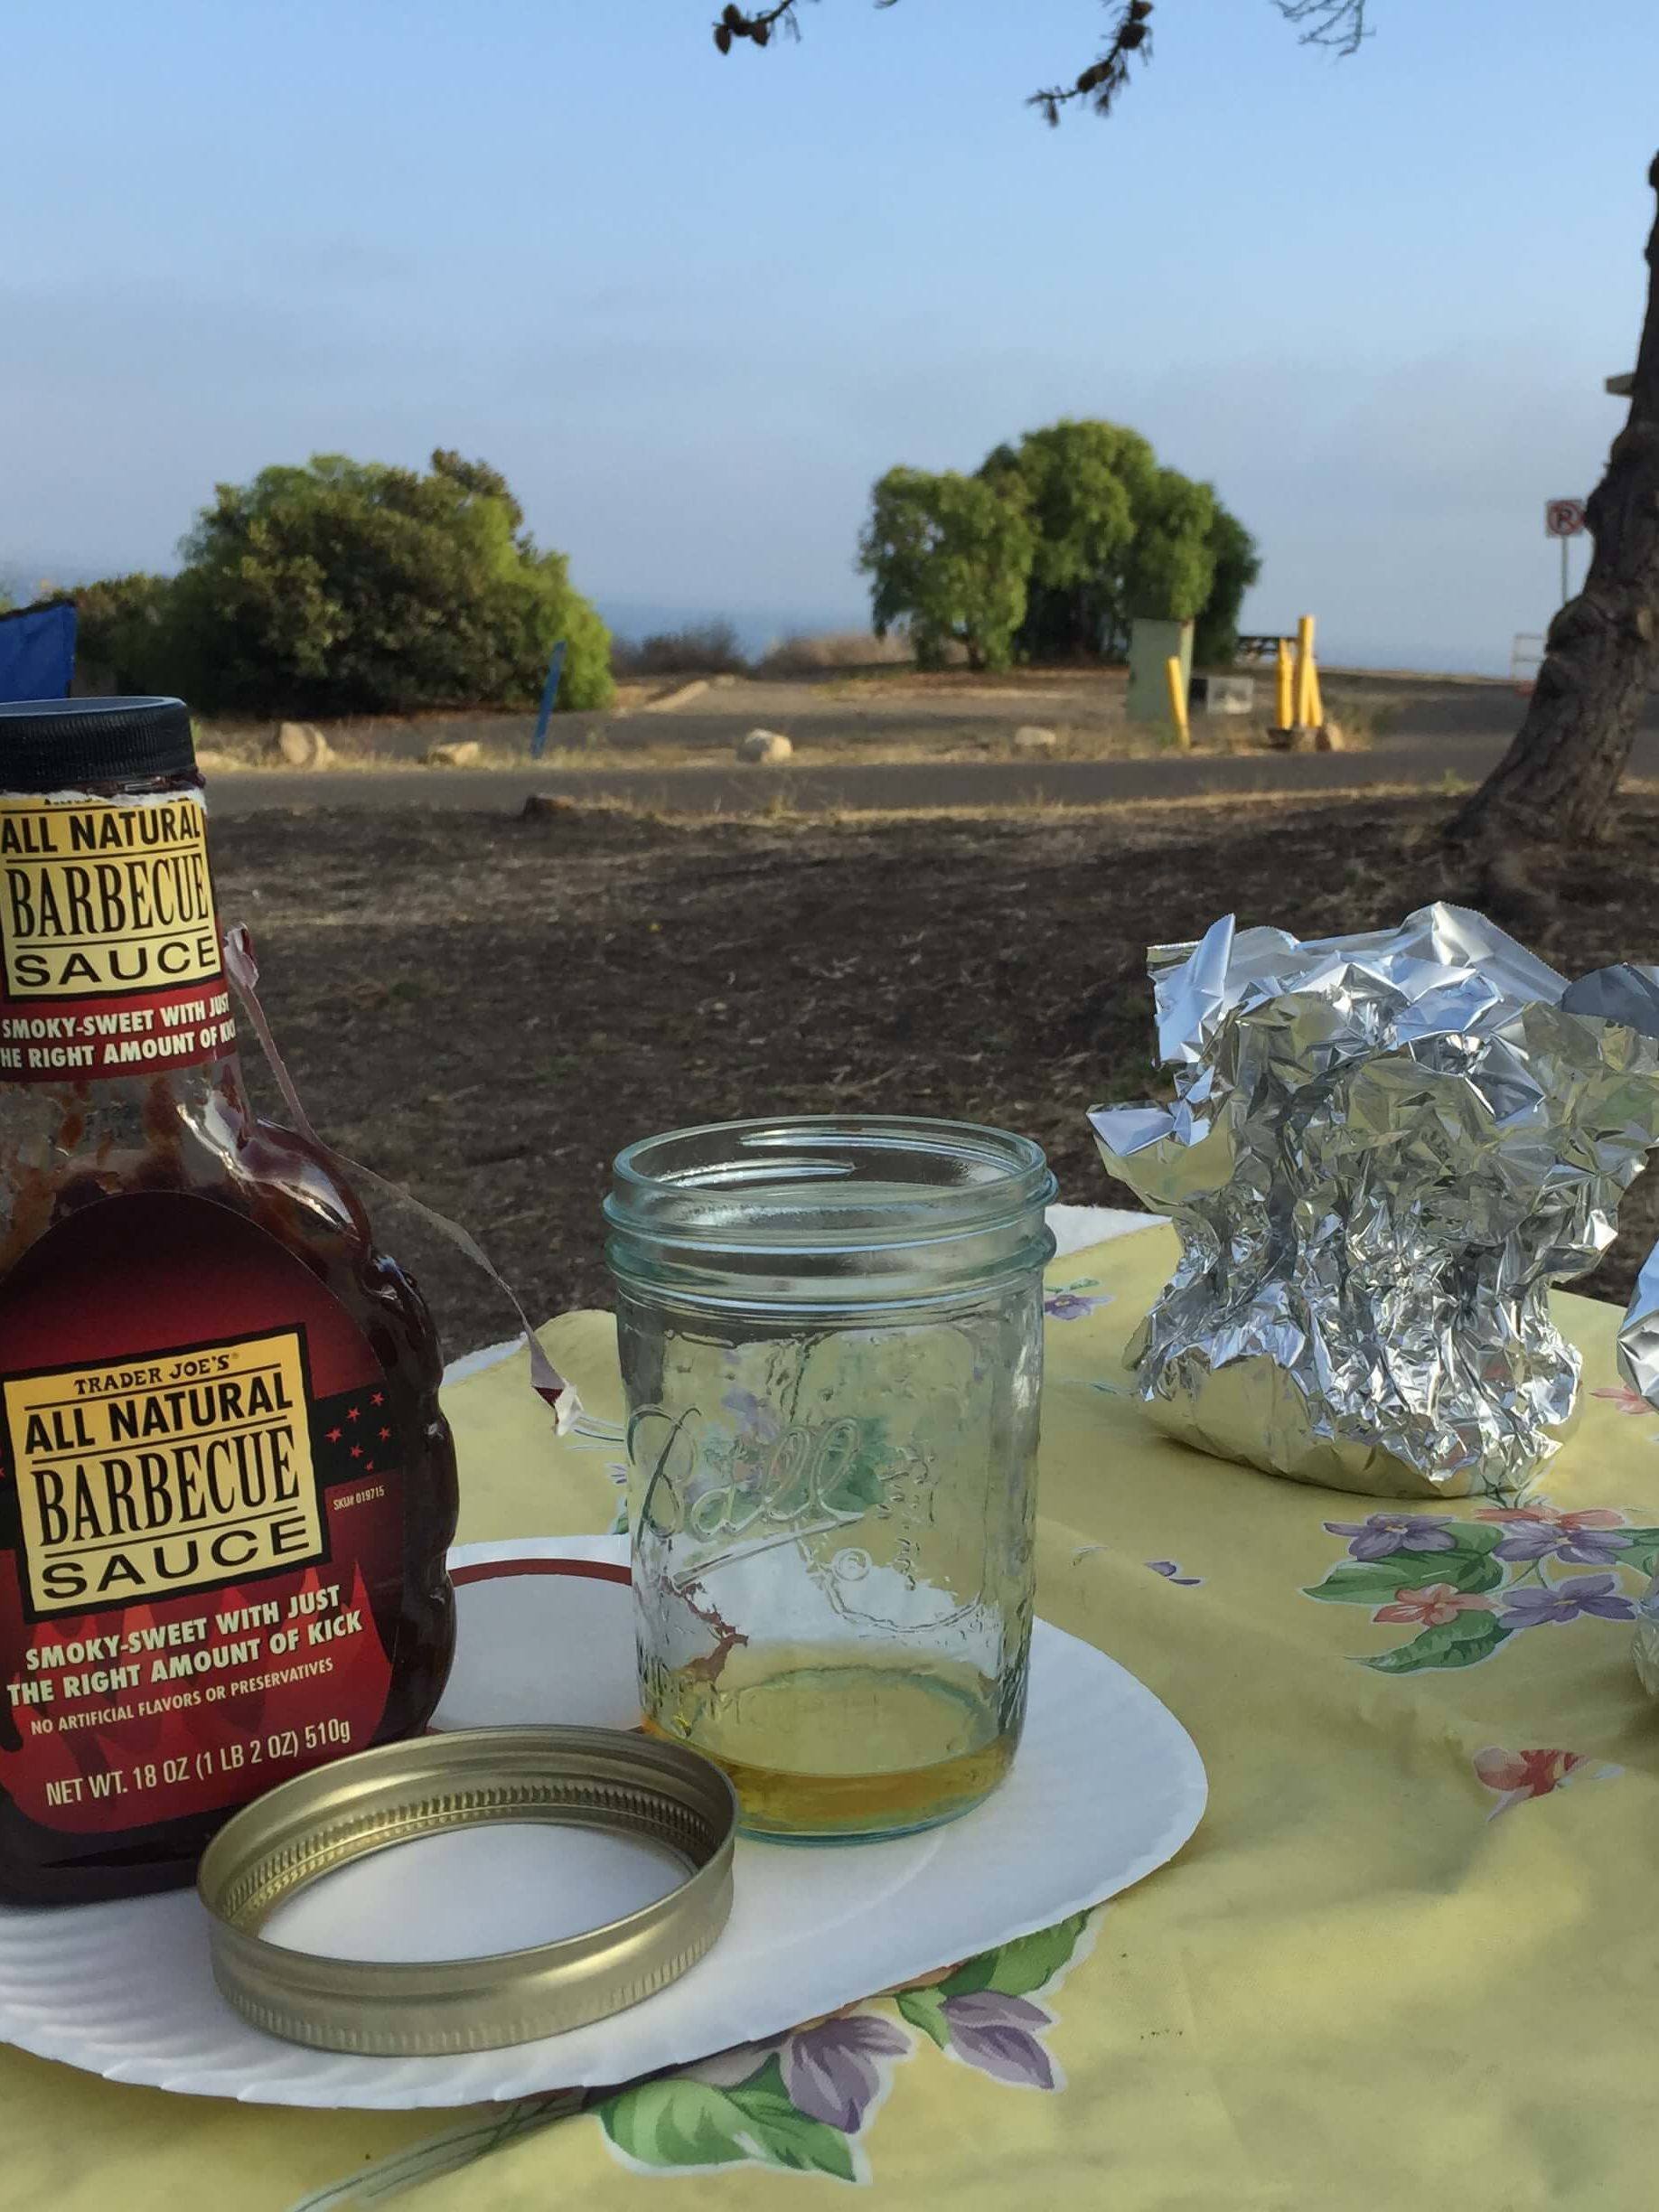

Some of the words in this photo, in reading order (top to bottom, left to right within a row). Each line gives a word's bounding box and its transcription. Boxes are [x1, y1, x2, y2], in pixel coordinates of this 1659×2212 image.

[2, 816, 58, 854] ALL
[69, 804, 200, 850] NATURAL
[6, 852, 209, 938] BARBECUE
[14, 935, 216, 988] SAUCE
[0, 1048, 22, 1068] HE
[28, 1045, 94, 1068] RIGHT
[103, 1032, 194, 1065] AMOUNT
[200, 1026, 218, 1049] OF
[2, 1008, 154, 1039] SMOKY-SWEET
[159, 1000, 206, 1027] WITH
[209, 991, 230, 1017] JUST
[25, 1408, 95, 1456] ALL
[108, 1372, 294, 1442] NATURAL
[74, 1367, 163, 1395] TRADER
[169, 1354, 230, 1380] JOE'S
[31, 1425, 301, 1548] BARBECUE
[355, 1485, 386, 1504] 019715
[626, 1404, 865, 1551] Ball
[42, 1515, 310, 1599] SAUCE
[6, 1680, 55, 1707] THE
[62, 1664, 141, 1700] RIGHT
[151, 1638, 261, 1684] AMOUNT
[269, 1628, 301, 1655] OF
[307, 1609, 363, 1646] KICK
[25, 1617, 207, 1672] SMOKY-SWEET
[215, 1600, 280, 1636] WITH
[287, 1584, 341, 1618] JUST
[31, 1719, 54, 1736] NO
[58, 1705, 135, 1732] ARTIFICIAL
[137, 1690, 202, 1718] FLAVORS
[205, 1685, 227, 1703] OR
[230, 1657, 334, 1697] PRESERVATIVES
[46, 1778, 84, 1807] NET
[88, 1770, 128, 1799] WT.
[133, 1764, 158, 1790] 18
[163, 1757, 191, 1784] OZ
[196, 1751, 214, 1781] (1
[220, 1744, 245, 1771] LB
[249, 1740, 263, 1764] 2
[267, 1730, 299, 1757] OZ)
[305, 1719, 351, 1748] 510g
